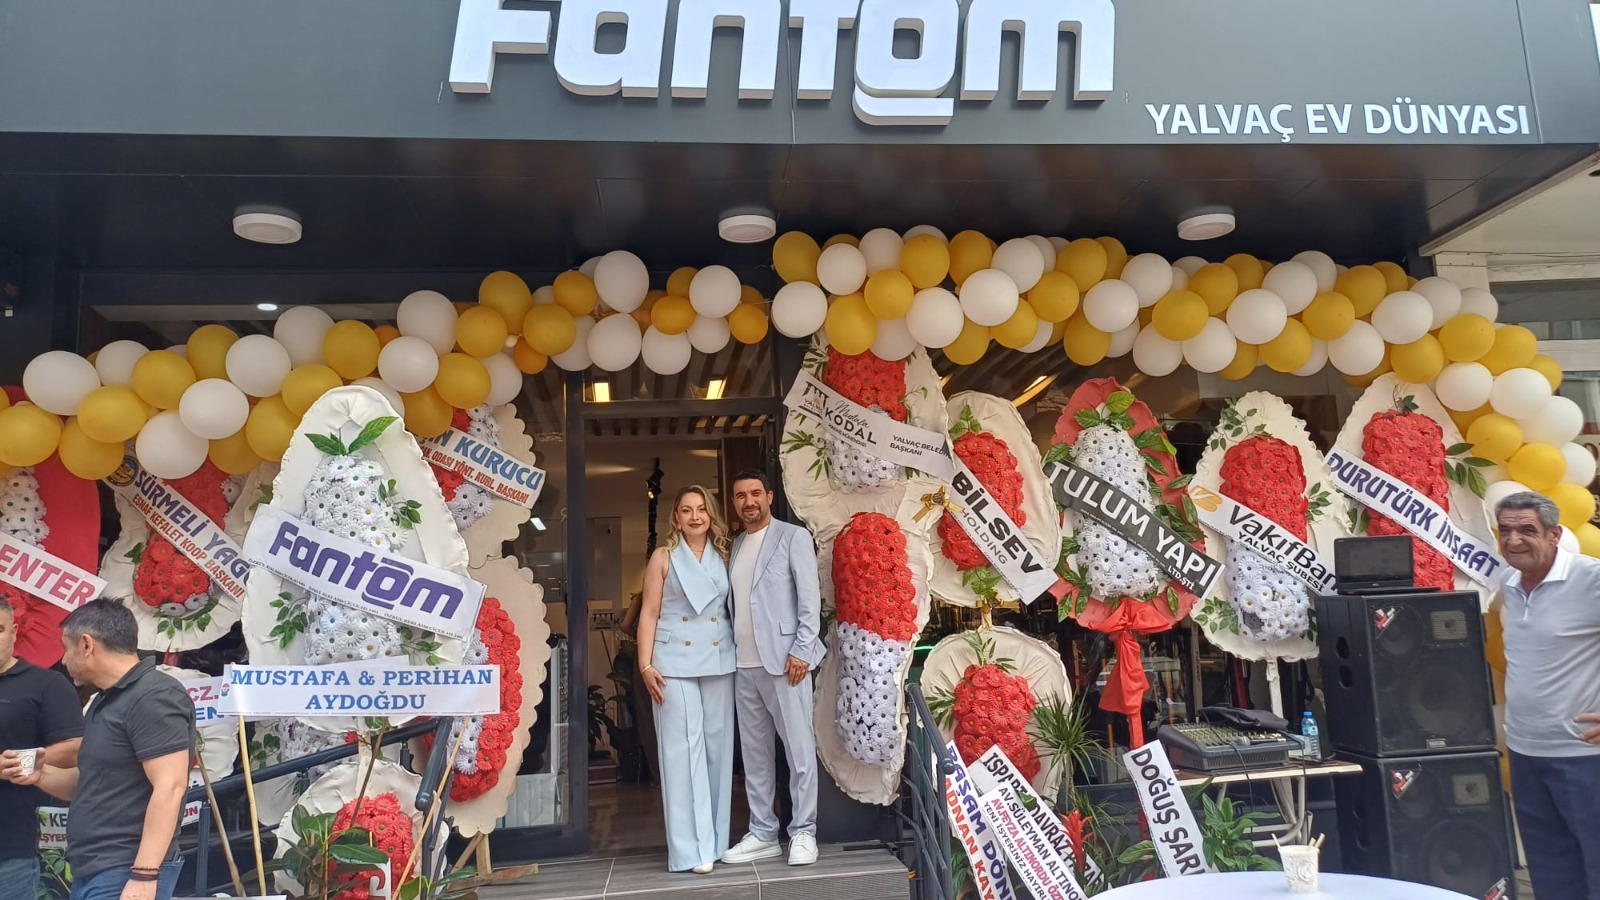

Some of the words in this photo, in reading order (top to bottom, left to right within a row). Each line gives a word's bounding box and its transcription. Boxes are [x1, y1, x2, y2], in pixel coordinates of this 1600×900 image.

[1145, 103, 1294, 142] YALVAÇ
[1305, 103, 1352, 134] EV
[1364, 96, 1530, 135] DÜNYASI
[825, 407, 877, 445] KODAL
[890, 442, 922, 456] BAŞKANI
[893, 434, 920, 448] YALVAÇ
[454, 436, 543, 490] KURUCU
[135, 469, 210, 537] SÜRMELİ
[496, 483, 530, 504] BAŞKANI
[1326, 453, 1438, 531] DURUTÜRK
[1436, 515, 1500, 578] İNŞAAT
[132, 493, 153, 514] ESNAF
[150, 510, 184, 541] KEFALET
[180, 538, 207, 560] KOOP
[204, 559, 245, 598] BAŞKANI
[1050, 462, 1150, 537] TULUM
[1156, 525, 1216, 587] YAPI
[1239, 532, 1284, 563] YALVAÇ
[1286, 561, 1325, 592] ŞUBESİ
[231, 669, 351, 686] MUSTAFA
[358, 670, 375, 687] &
[384, 666, 493, 686] PERİHAN
[305, 690, 426, 710] AYDOĞDU
[1131, 748, 1180, 825] DOĞUŞ
[984, 801, 998, 823] YENİ
[996, 823, 1027, 870] İŞYERİNİZ
[991, 798, 1019, 840] AV.FEYZA
[1015, 837, 1053, 887] ALTINORDU
[998, 787, 1051, 861] AV.SÜLEYMAN
